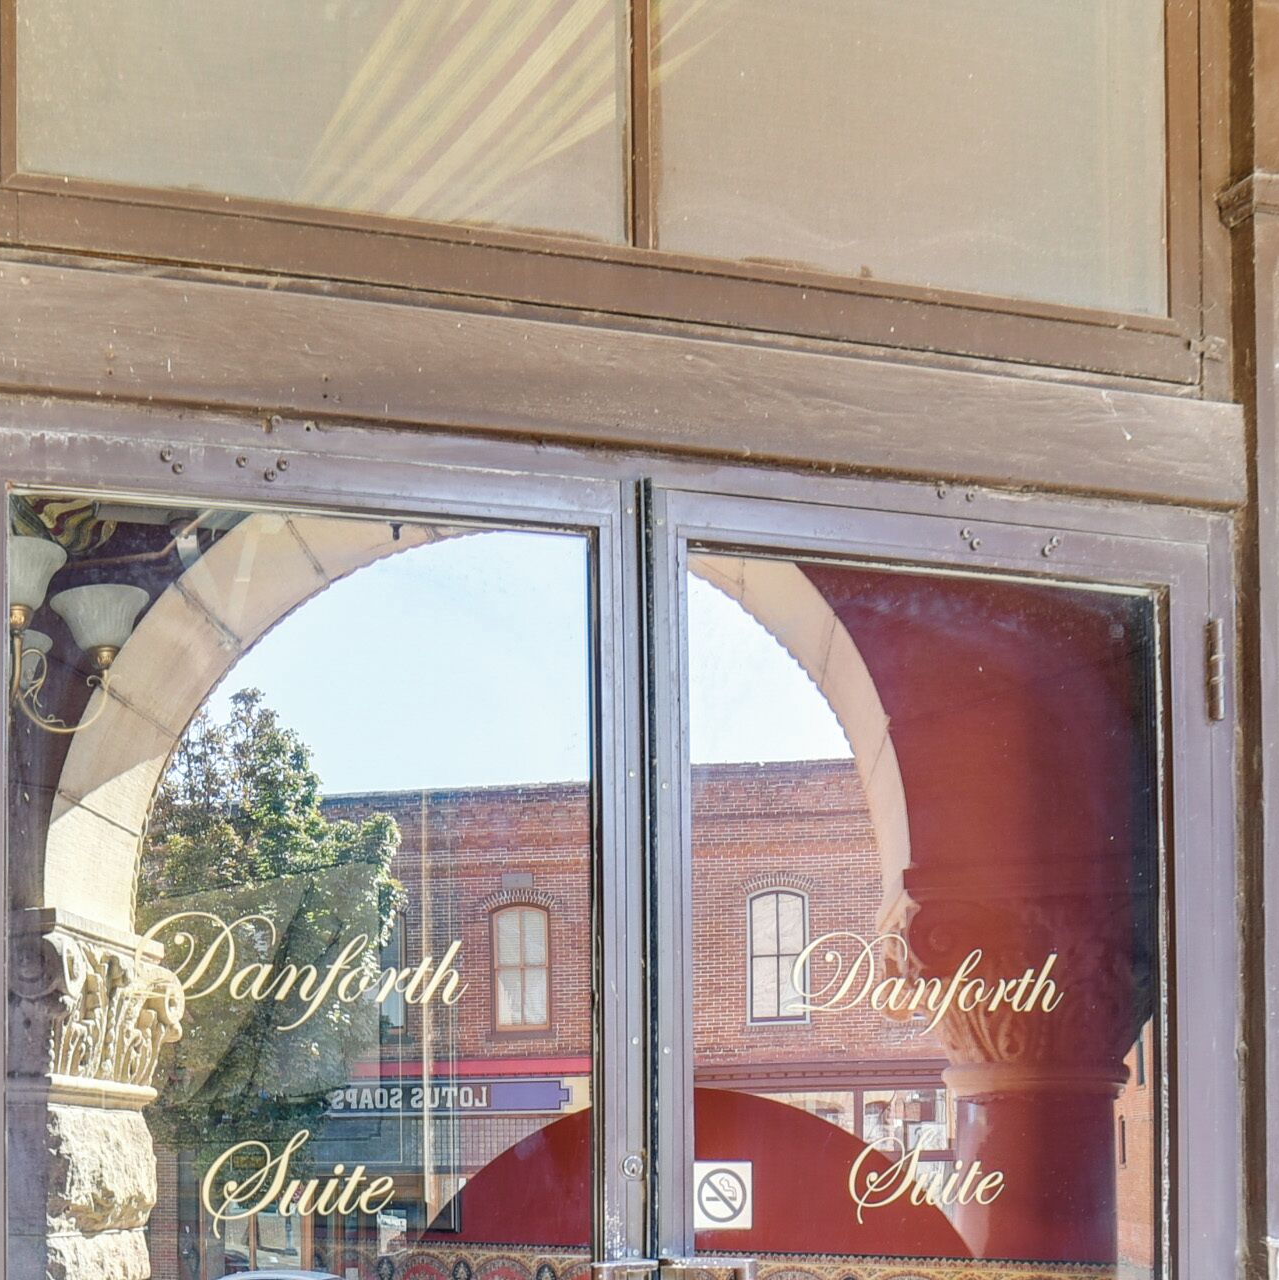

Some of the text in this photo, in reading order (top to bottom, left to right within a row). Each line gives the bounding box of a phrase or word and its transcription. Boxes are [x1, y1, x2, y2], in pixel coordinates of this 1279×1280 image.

[128, 911, 470, 1032] Danforth
[785, 931, 1065, 1036] Danforth
[201, 1128, 396, 1240] Suite
[847, 1128, 1006, 1226] Suite
